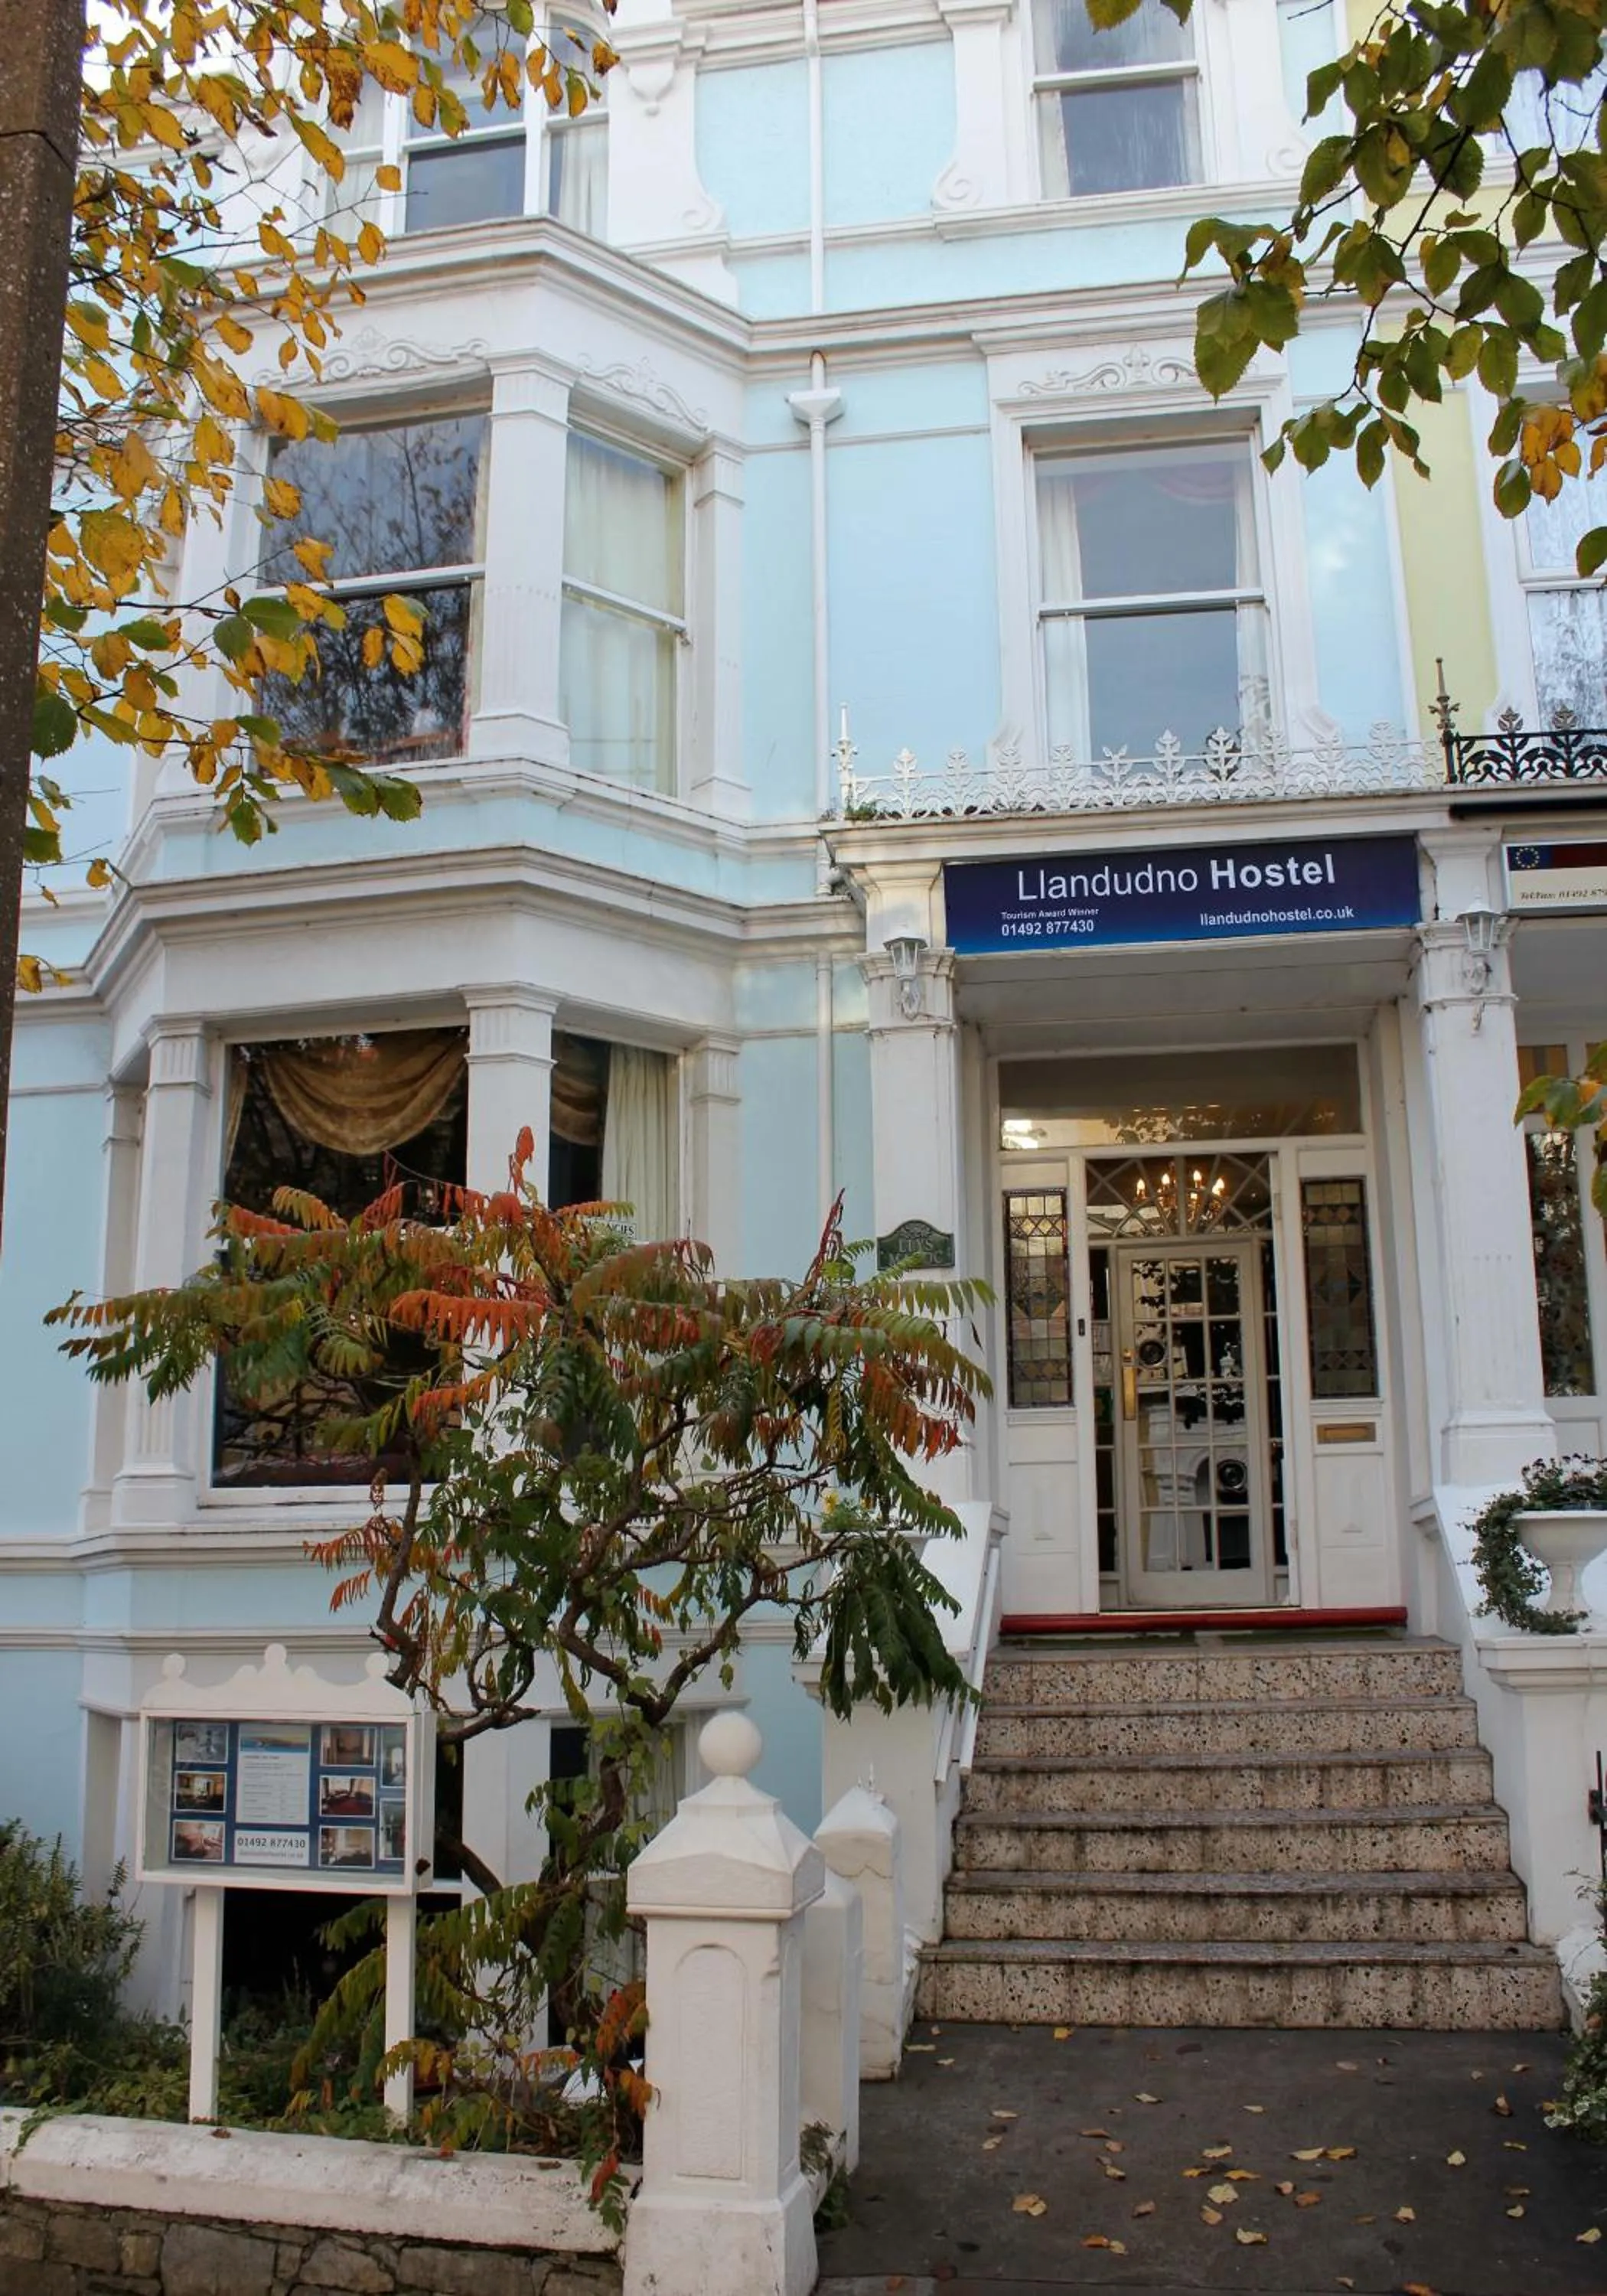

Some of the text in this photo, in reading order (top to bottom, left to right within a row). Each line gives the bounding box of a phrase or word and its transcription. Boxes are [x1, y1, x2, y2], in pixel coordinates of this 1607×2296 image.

[1019, 853, 1335, 901] Llandudno Hostel
[1001, 907, 1100, 920] Tourism Award Winner
[1200, 905, 1354, 925] llandudnohostel.co.uk
[1001, 920, 1094, 936] 01492 877430
[237, 1837, 305, 1848] 01492 877430
